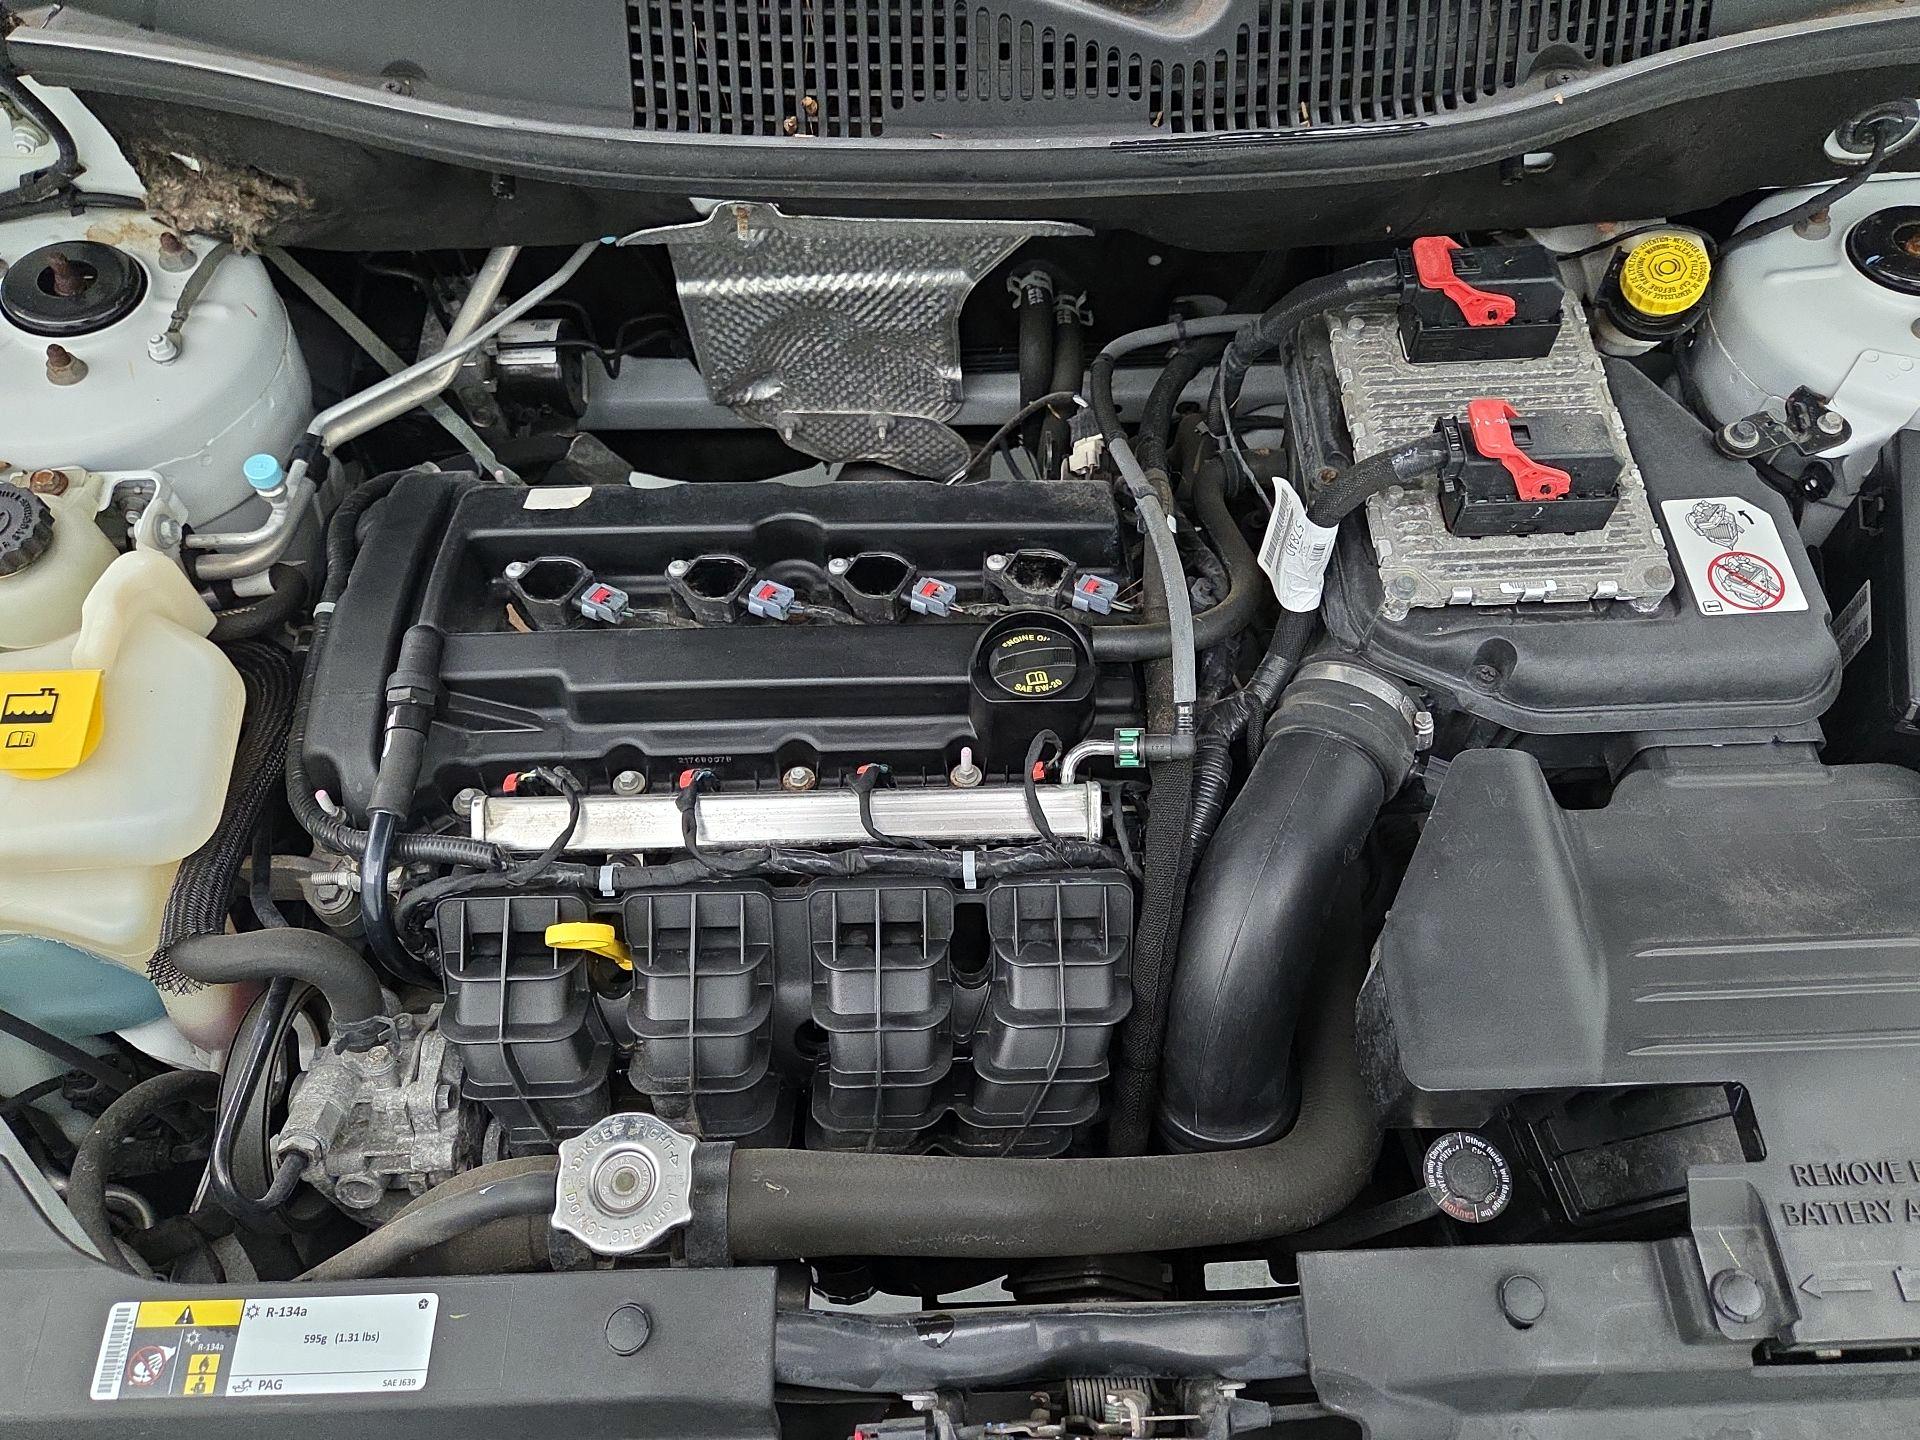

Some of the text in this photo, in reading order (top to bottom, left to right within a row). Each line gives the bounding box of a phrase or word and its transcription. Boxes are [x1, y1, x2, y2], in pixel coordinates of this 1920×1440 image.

[1649, 283, 1677, 293] BEFORE
[1679, 280, 1691, 290] CAP
[1014, 678, 1063, 693] SAE 5W-20
[580, 1121, 625, 1155] KEEP
[1464, 1135, 1487, 1149] Other
[1426, 1139, 1450, 1188] Use only Chrysler
[1486, 1146, 1504, 1167] fluids
[1435, 1161, 1444, 1179] Fluid
[1499, 1168, 1510, 1183] will
[1790, 1160, 1906, 1187] REMOVE
[1437, 1179, 1449, 1193] CVT
[1491, 1184, 1510, 1211] damage
[565, 1192, 581, 1214] DO
[577, 1215, 608, 1239] NOT
[610, 1218, 654, 1243] OPEN
[1442, 1200, 1475, 1220] CAUTION
[1480, 1208, 1494, 1217] the
[1780, 1199, 1895, 1227] BATTERY
[266, 1306, 308, 1318] R-134a
[303, 1330, 380, 1346] 595g (1.31 lbs)
[197, 1342, 225, 1351] R-134a
[258, 1378, 417, 1391] PAG SAE J639
